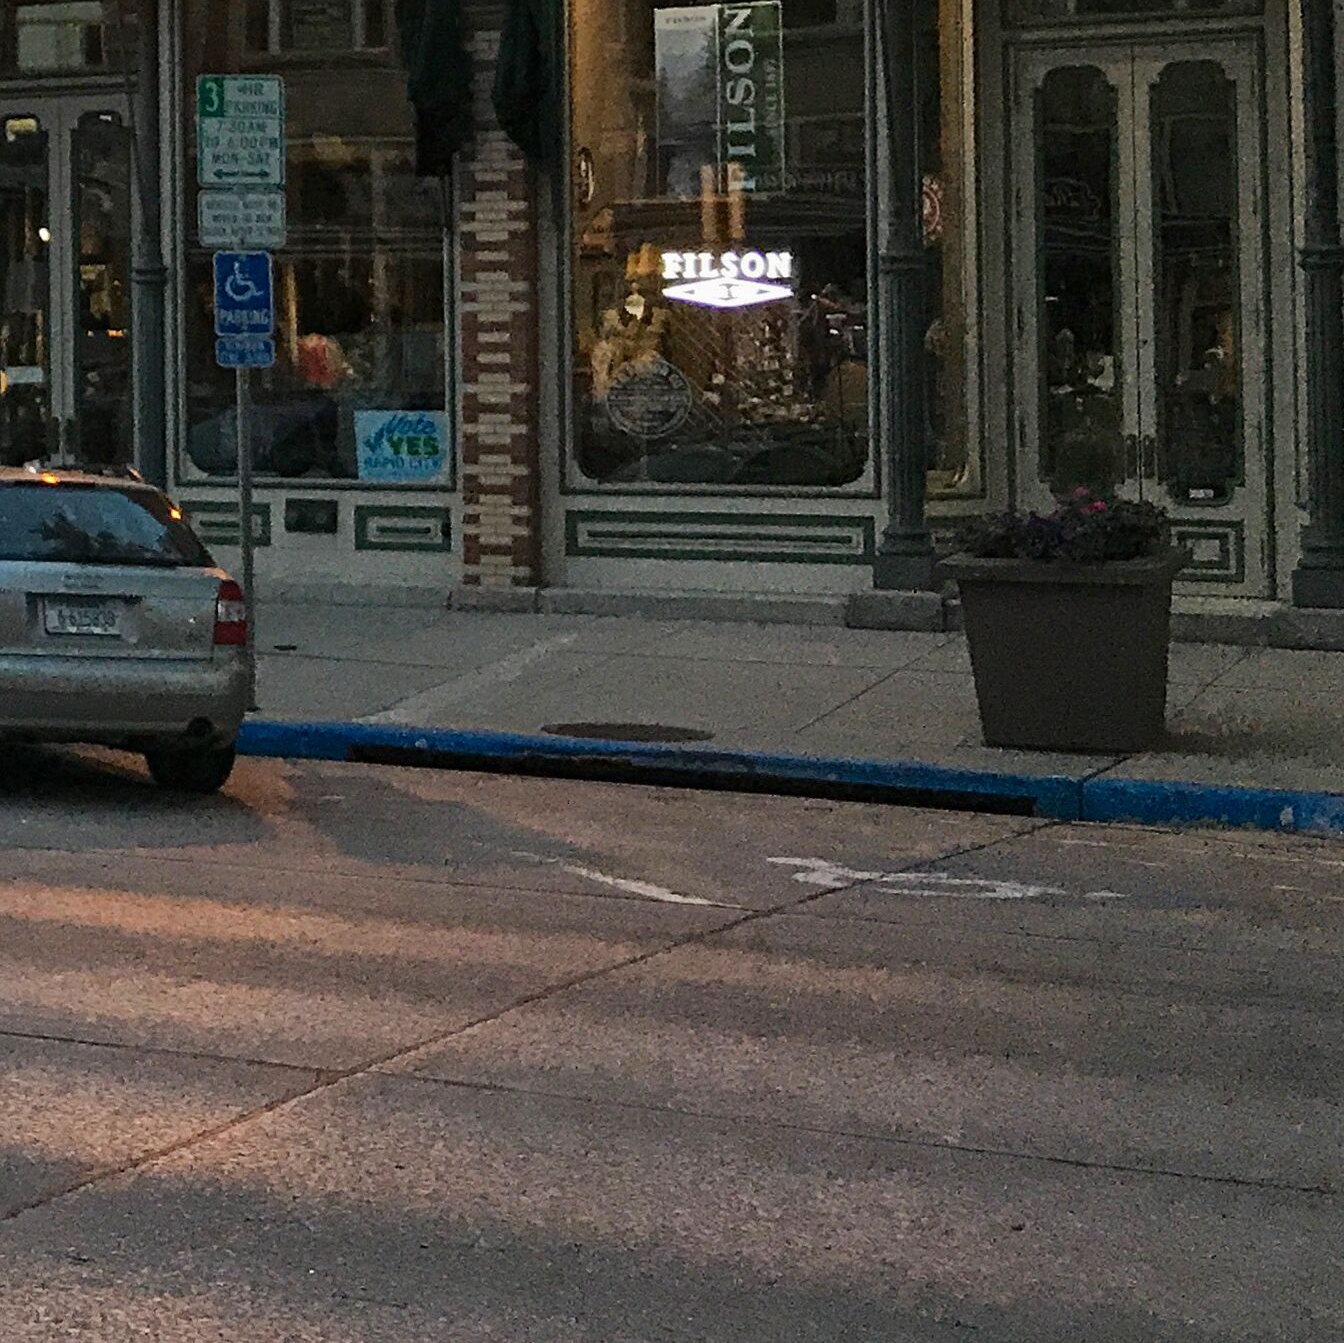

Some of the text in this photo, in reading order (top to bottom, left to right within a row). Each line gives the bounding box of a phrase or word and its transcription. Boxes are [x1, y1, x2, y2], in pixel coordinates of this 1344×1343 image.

[204, 81, 220, 113] 3
[225, 100, 278, 115] PARKING
[723, 8, 756, 192] FILSON
[661, 252, 793, 280] FILSON
[387, 435, 439, 456] YES
